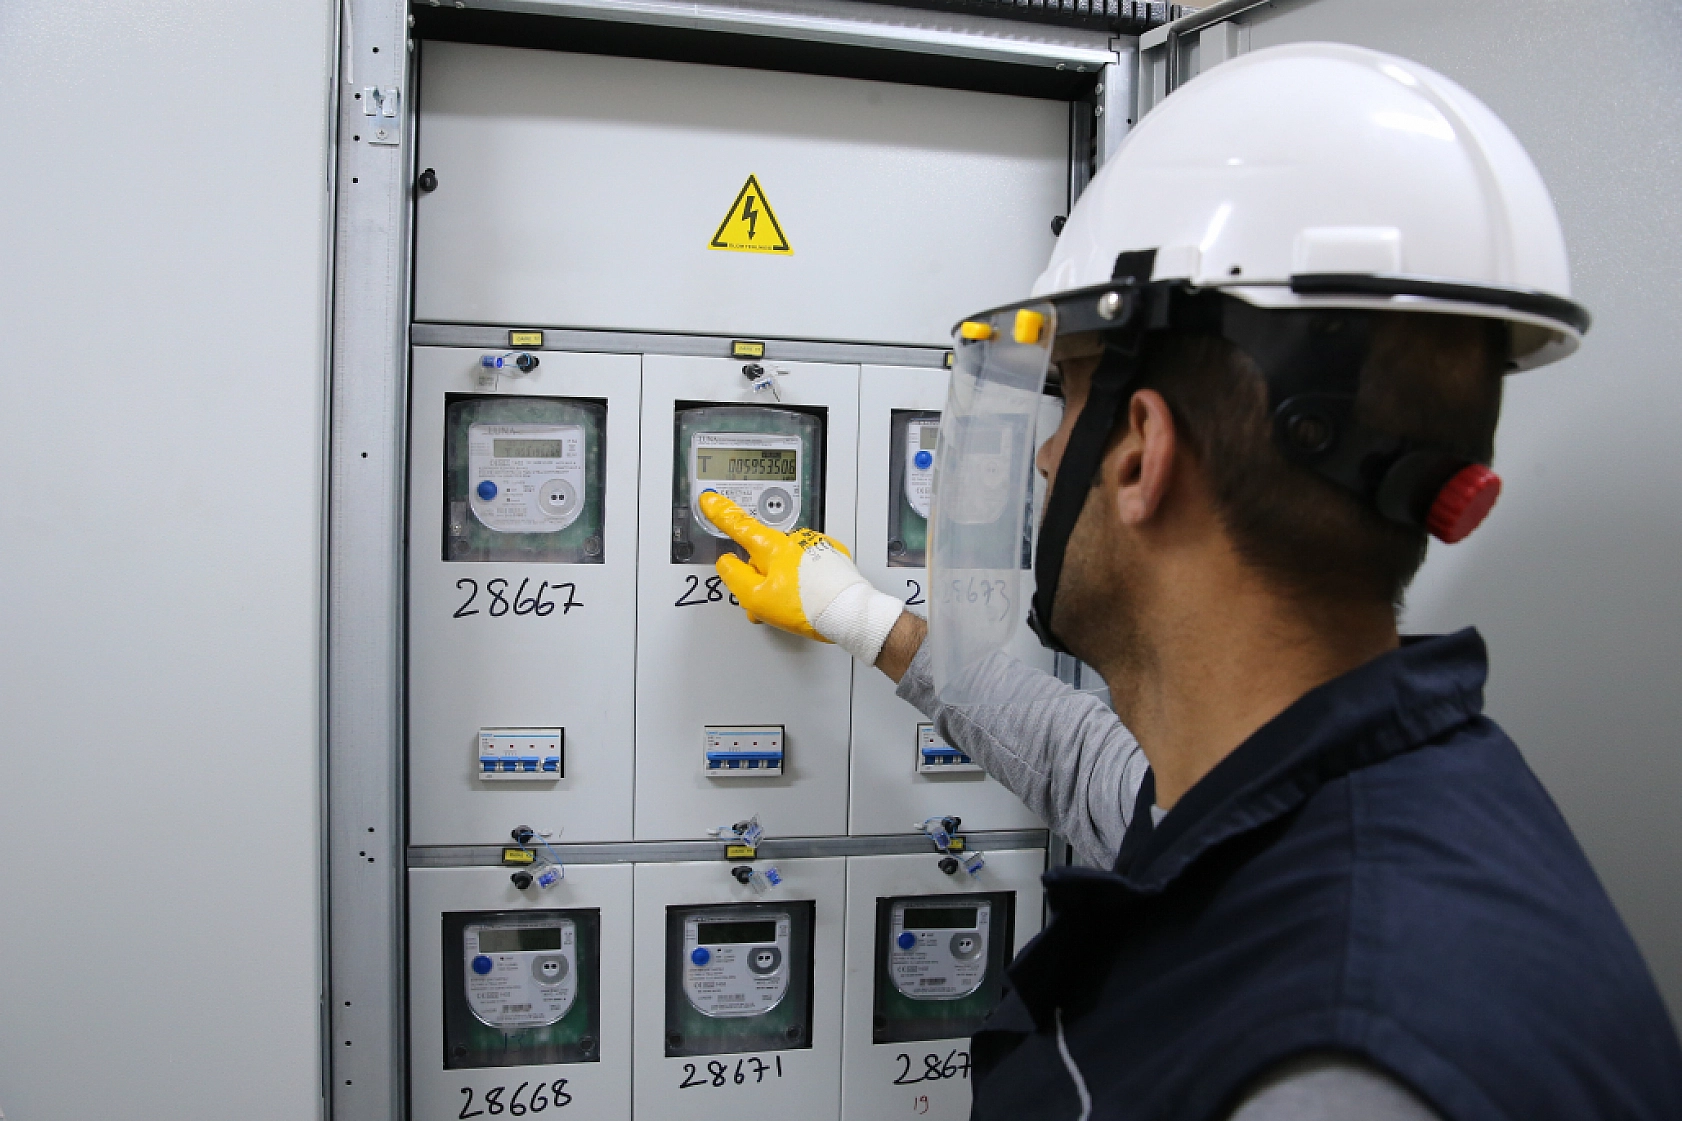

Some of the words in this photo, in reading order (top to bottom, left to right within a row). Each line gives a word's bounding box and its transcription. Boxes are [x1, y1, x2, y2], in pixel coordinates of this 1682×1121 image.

[698, 455, 714, 473] T
[453, 577, 584, 618] 28667
[679, 1056, 782, 1088] 28671
[459, 1079, 572, 1120] 28668
[913, 1094, 930, 1115] 19
